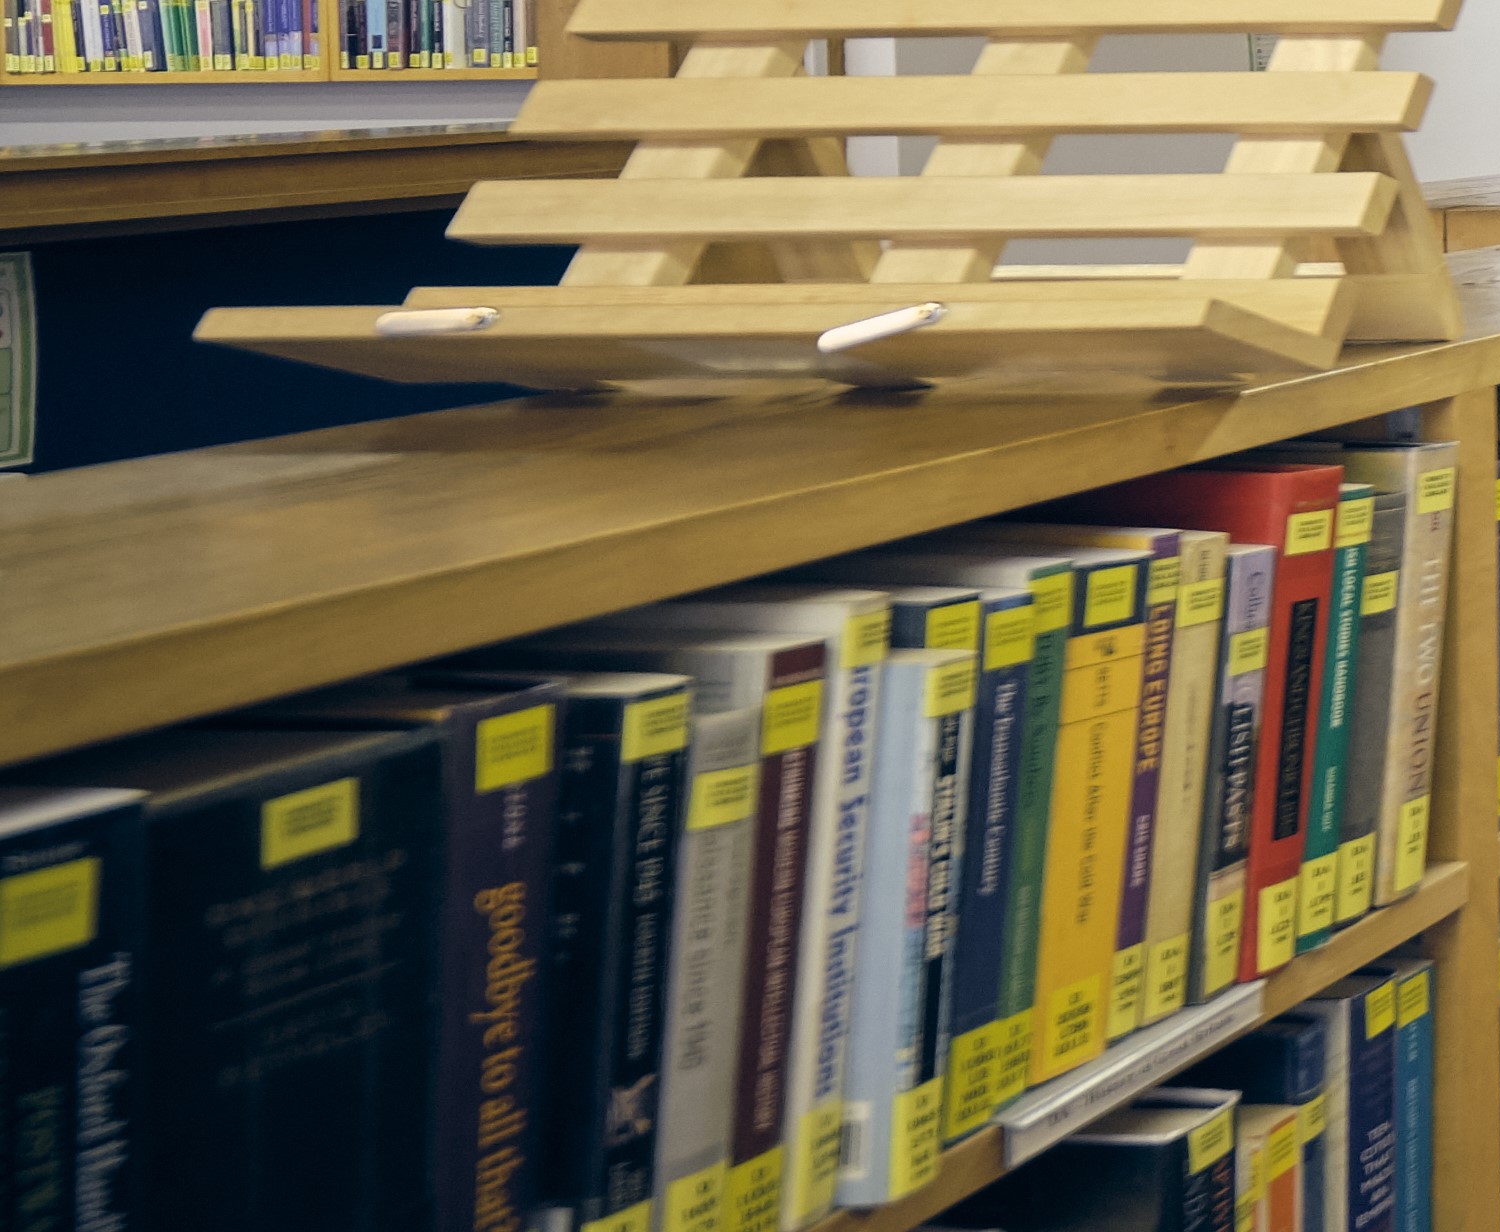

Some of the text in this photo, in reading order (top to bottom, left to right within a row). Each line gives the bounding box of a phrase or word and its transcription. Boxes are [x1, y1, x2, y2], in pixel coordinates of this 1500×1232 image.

[1341, 569, 1359, 605] LOCAL
[1417, 555, 1442, 607] THE
[1335, 609, 1356, 658] STUDIES
[1415, 622, 1439, 686] TWO
[1329, 659, 1351, 728] HANDBOOK
[1135, 679, 1169, 775] EUROPE
[927, 773, 959, 858] STALIN'S
[1082, 783, 1104, 823] After
[1220, 772, 1251, 852] PASTS
[692, 831, 724, 941] aissance
[813, 668, 877, 1099] uropean Security Institutions
[975, 824, 1003, 897] Century
[923, 913, 949, 961] WAR
[1075, 892, 1096, 926] War
[468, 881, 537, 1045] goodbye
[479, 1046, 526, 1095] to
[476, 1095, 528, 1148] all
